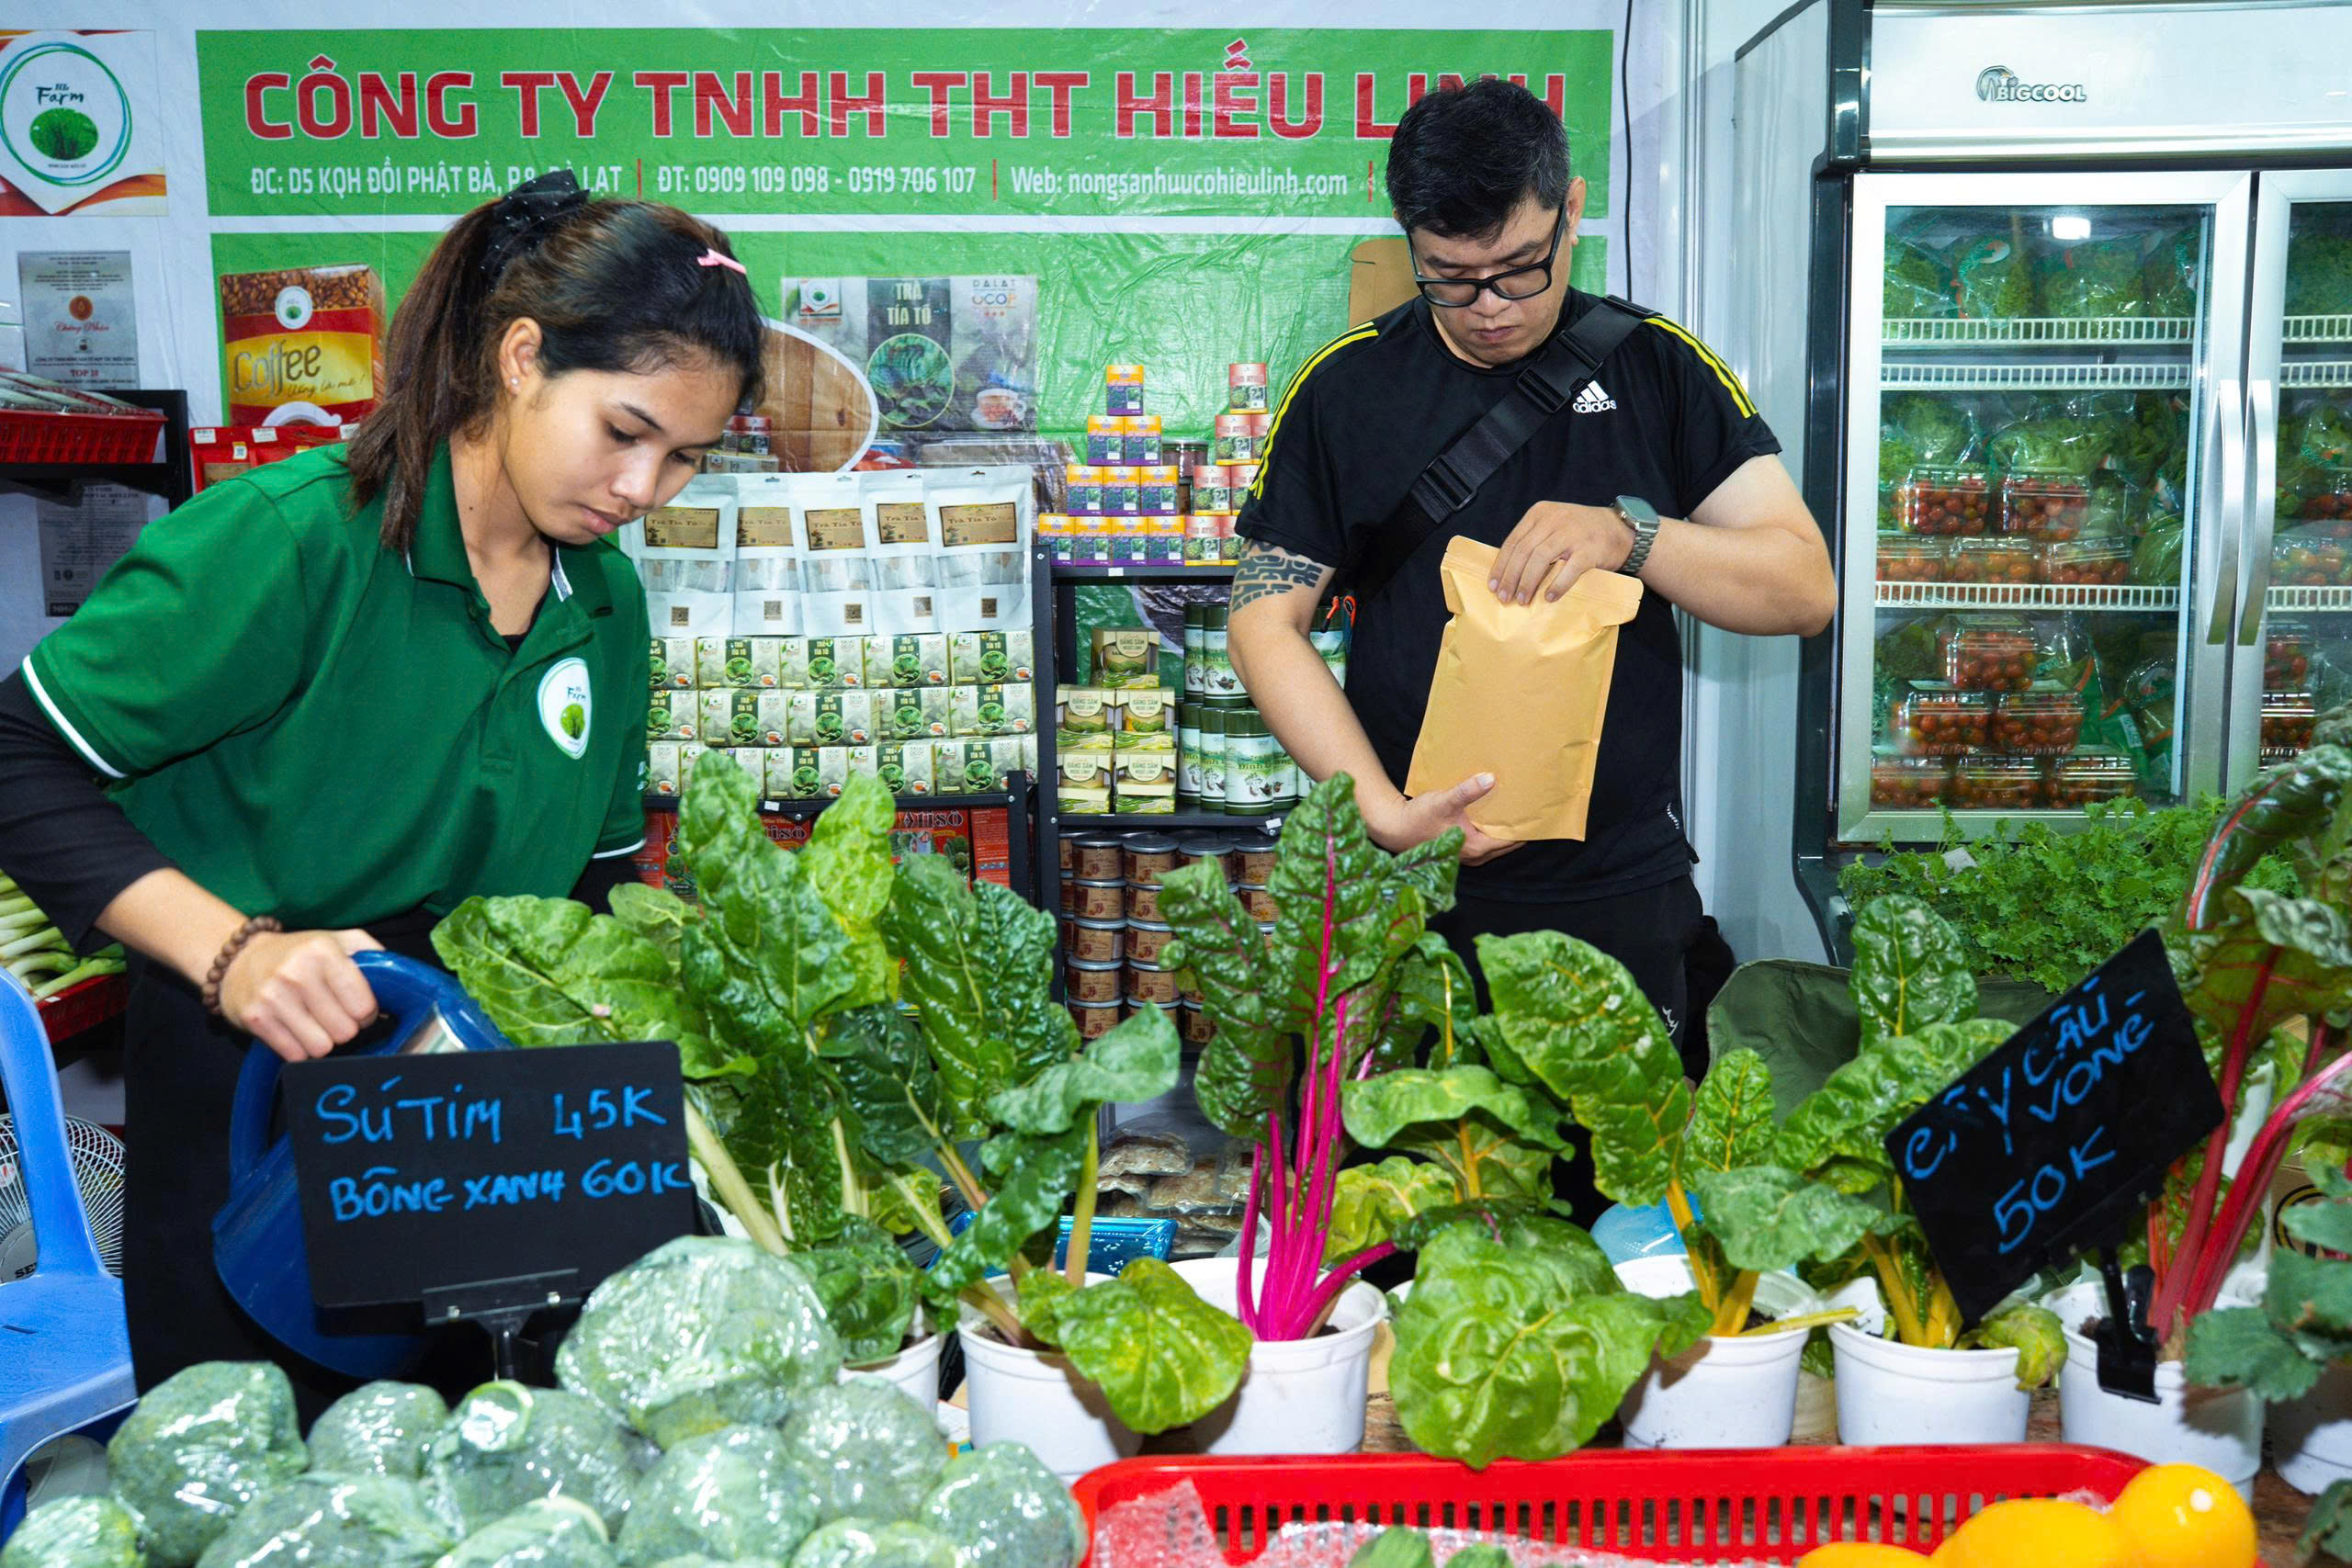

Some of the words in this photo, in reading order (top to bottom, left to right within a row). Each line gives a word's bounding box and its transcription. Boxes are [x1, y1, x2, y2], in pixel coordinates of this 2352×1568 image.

[36, 85, 85, 106] Farm
[244, 53, 479, 141] CÔNG
[501, 71, 615, 139] TY
[633, 71, 886, 139] TNHH
[911, 71, 1089, 139] THT
[1114, 37, 1325, 140] HIẾU
[251, 167, 283, 194] ĐC:
[318, 166, 361, 199] KQH
[367, 155, 403, 194] ĐỒI
[408, 160, 462, 198] PHẬT
[657, 165, 690, 193] ĐT:
[695, 166, 746, 193] 0909
[752, 166, 785, 193] 109
[790, 166, 829, 193] 098
[848, 165, 896, 193] 0919
[900, 166, 937, 193] 706
[943, 165, 978, 193] 107
[1011, 166, 1063, 194] Web:
[1069, 165, 1349, 201] nongsanhuucohieulinh.com
[234, 339, 322, 398] Coffee
[1572, 400, 1617, 414] adidas
[553, 1084, 668, 1141] 45K
[464, 1169, 565, 1211] XANH
[581, 1157, 692, 1199] 60K
[1993, 1125, 2117, 1254] 50K
